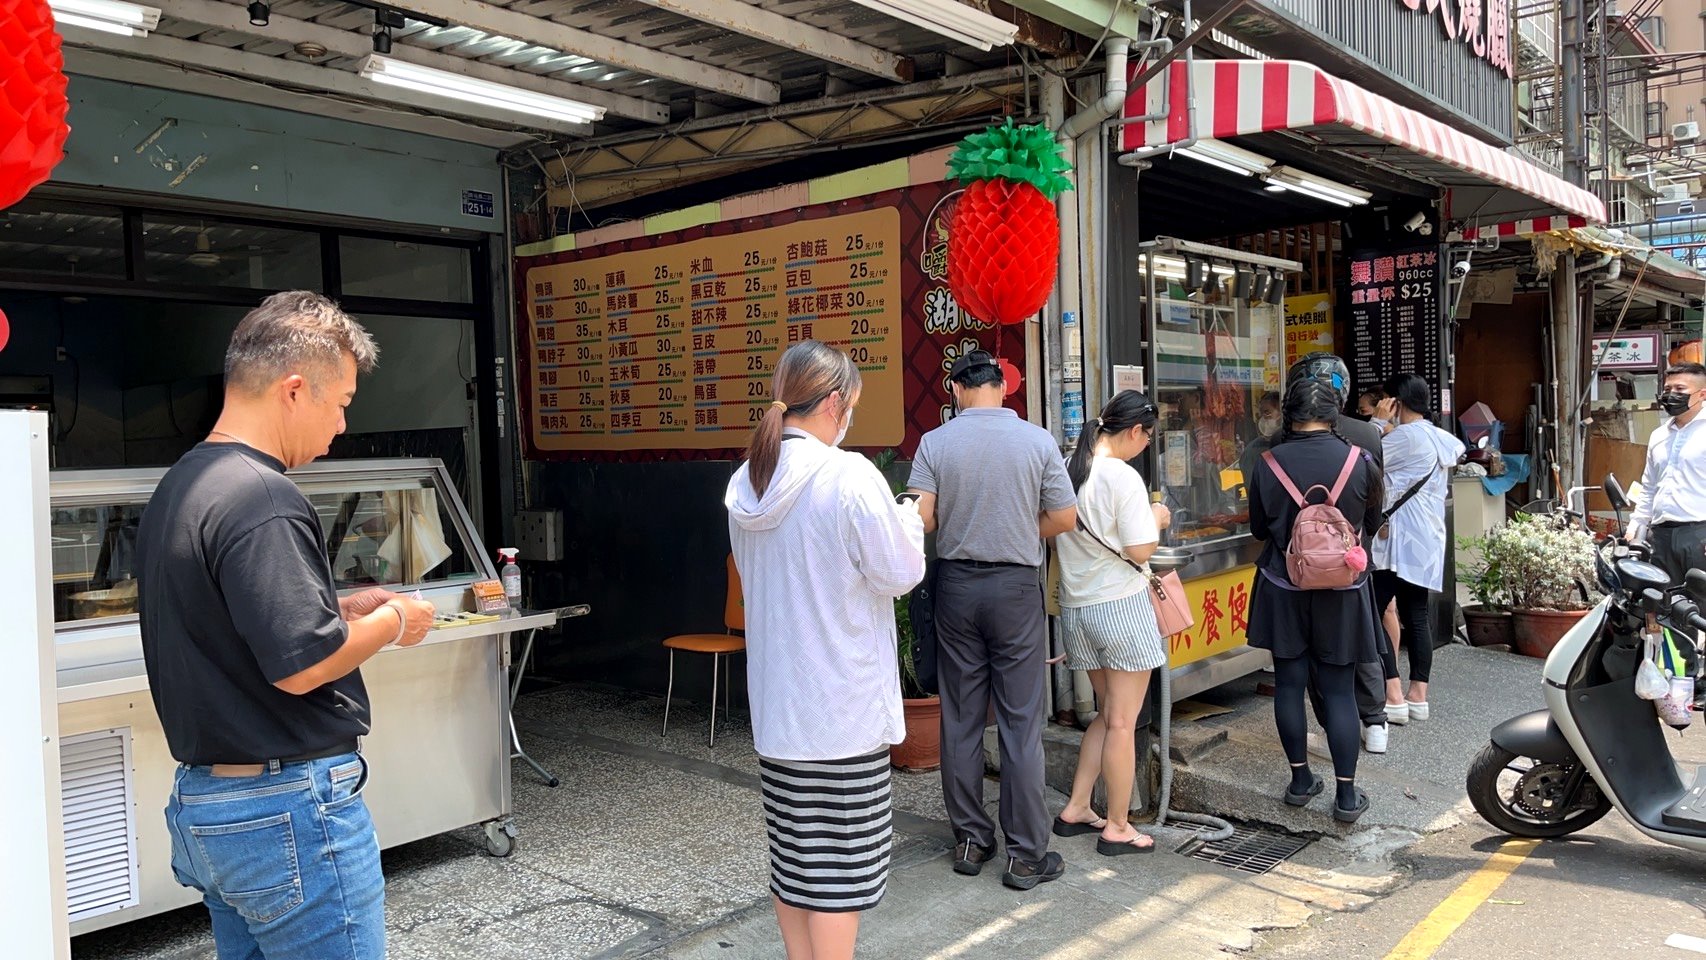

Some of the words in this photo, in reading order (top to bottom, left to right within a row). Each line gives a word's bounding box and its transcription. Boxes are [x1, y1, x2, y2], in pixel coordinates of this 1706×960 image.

[786, 239, 827, 261] 杏鮑菇
[690, 256, 713, 274] 米血
[1396, 250, 1437, 269] 紅茶冰
[786, 269, 812, 288] 豆包
[1398, 269, 1433, 281] 960cc
[691, 281, 726, 300] 黑豆乾
[1401, 282, 1432, 300] $25
[607, 293, 638, 311] 馬鈴薯
[787, 293, 843, 315] 綠花椰菜
[691, 306, 727, 325] 甜不辣
[607, 318, 628, 335] 木耳
[787, 323, 813, 342] 百頁
[609, 341, 638, 358] 小黃瓜
[692, 332, 715, 350] 豆皮
[538, 348, 565, 363] 鴨脖子
[609, 365, 640, 381] 玉米筍
[693, 358, 716, 375] 海帶
[540, 393, 557, 407] 鴨舌
[610, 389, 630, 404] 秋葵
[694, 383, 717, 400] 鳥蛋
[541, 414, 568, 429] 鴨肉丸
[610, 412, 642, 427] 四季豆
